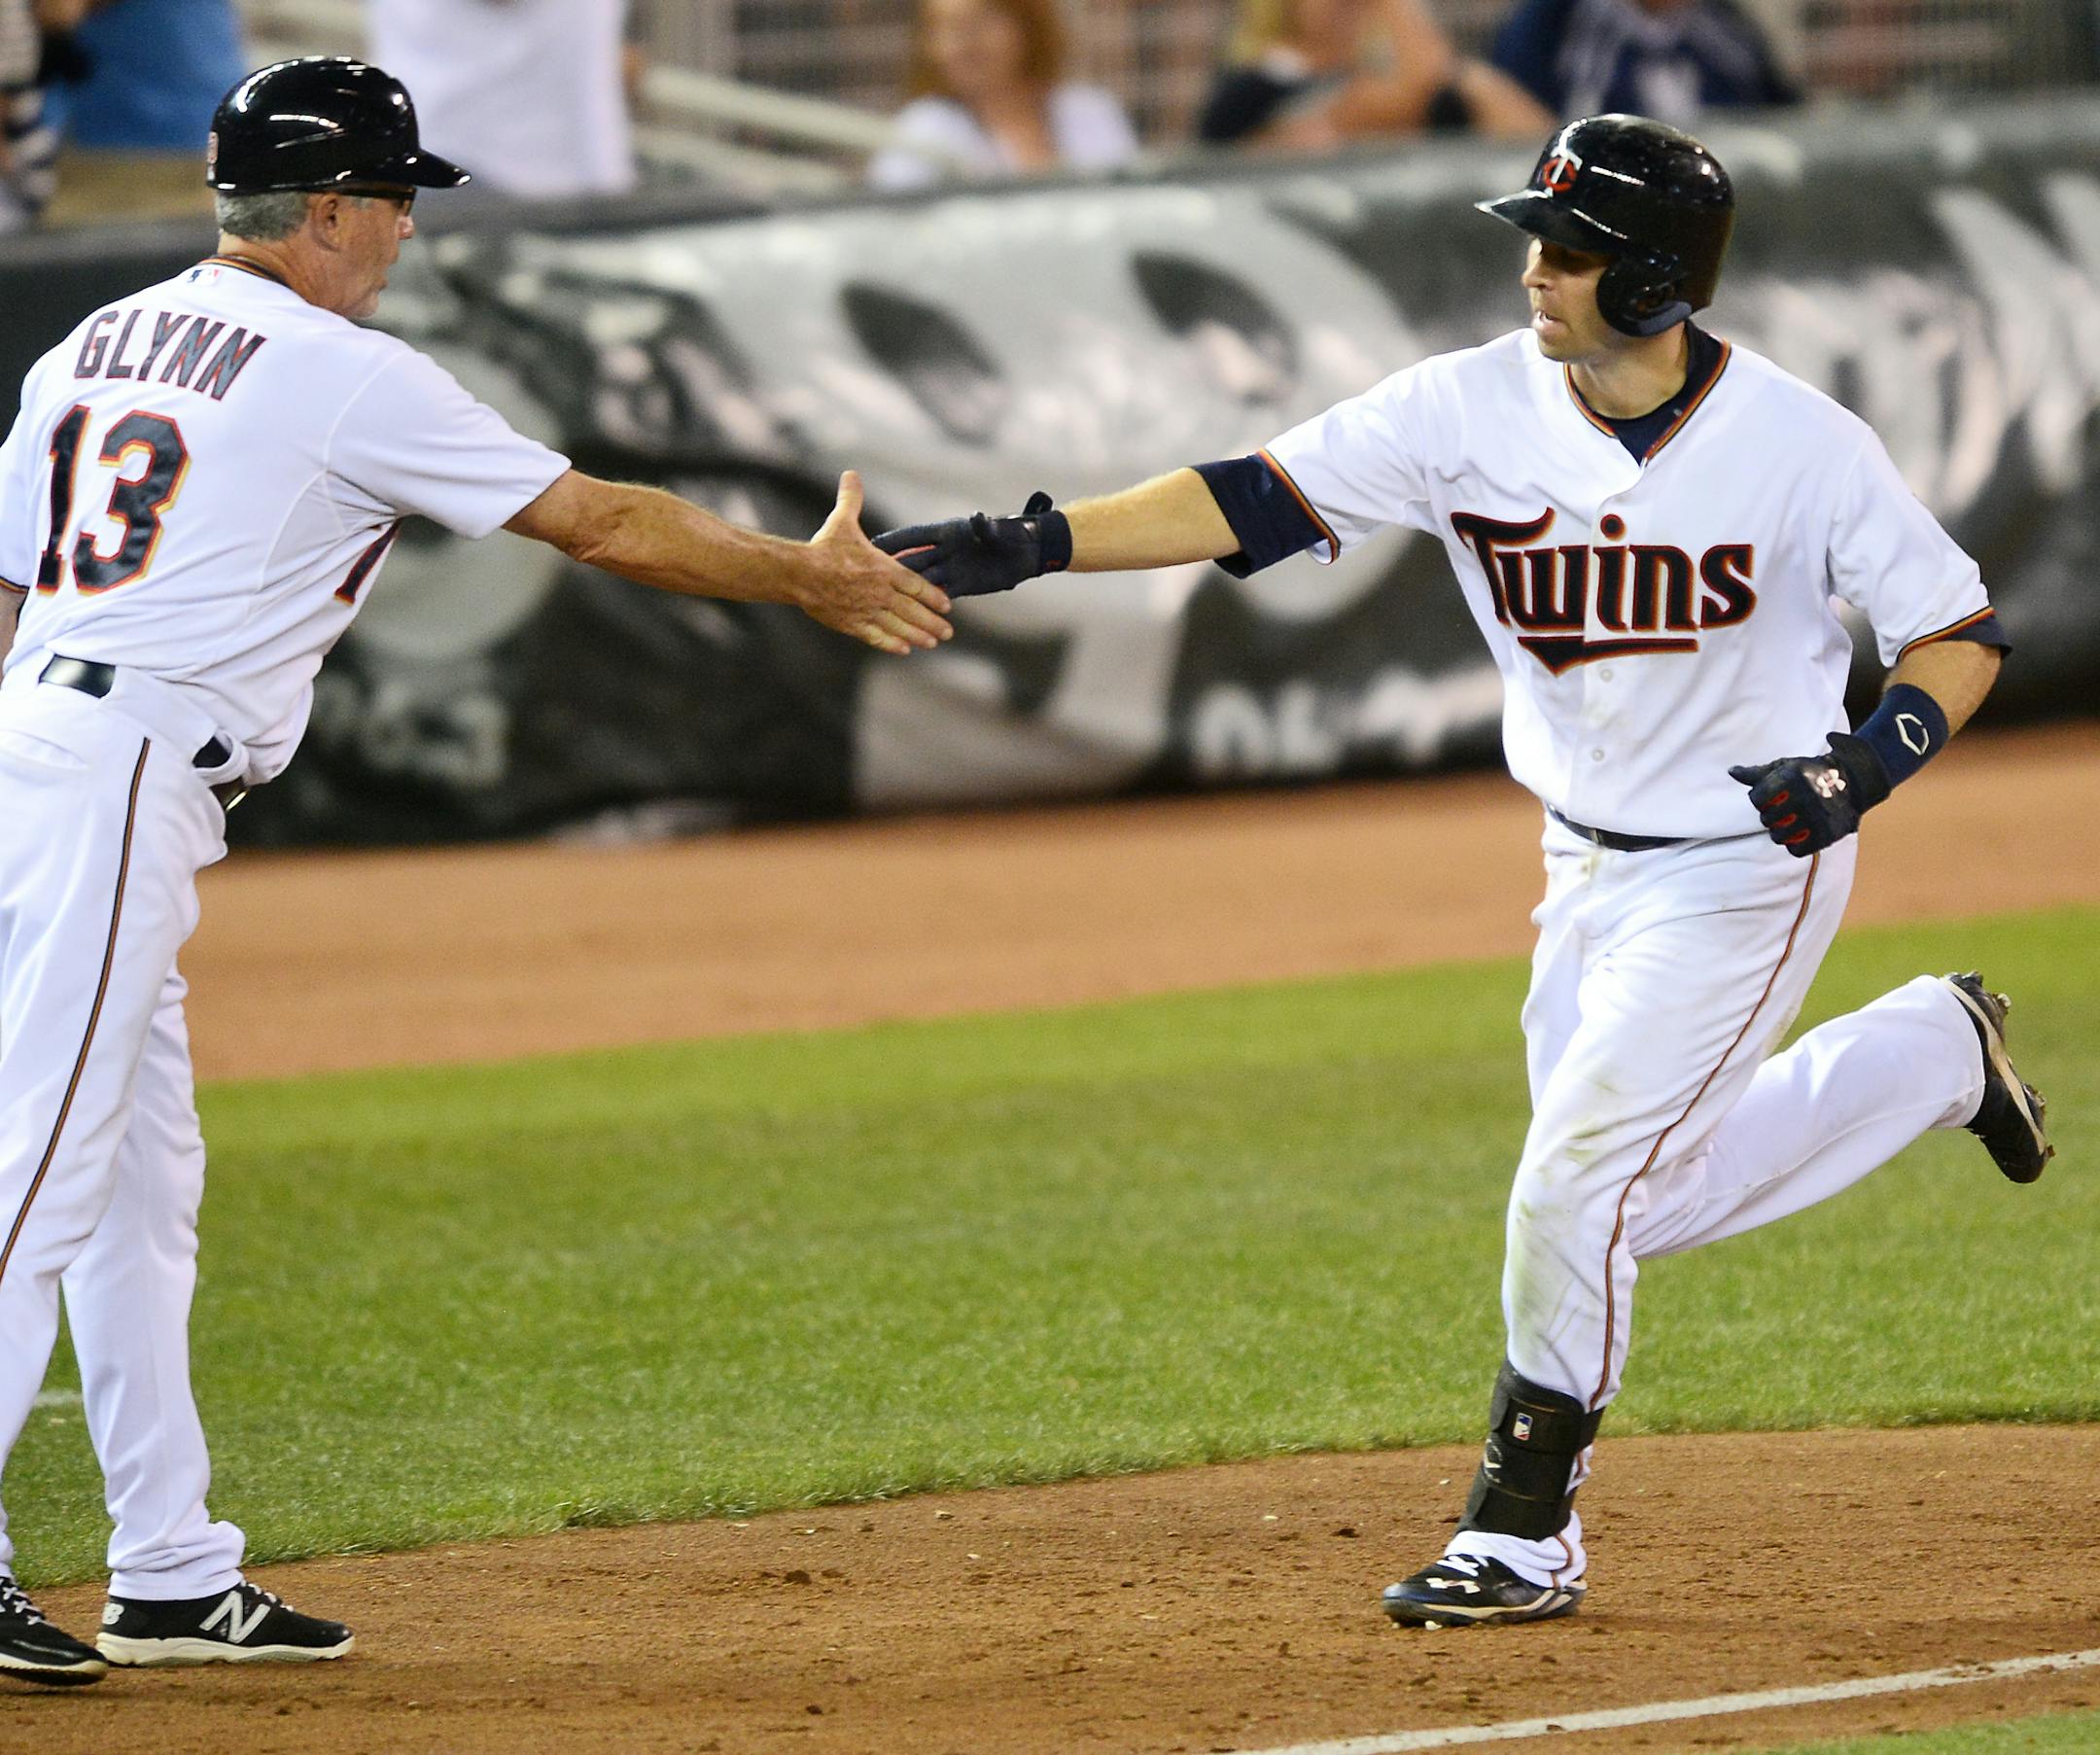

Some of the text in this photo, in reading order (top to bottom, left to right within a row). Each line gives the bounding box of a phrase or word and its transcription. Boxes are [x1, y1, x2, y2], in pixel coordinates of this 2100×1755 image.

[74, 308, 267, 402] GLYNN
[36, 404, 192, 597] 13
[1450, 506, 1758, 633] Twins
